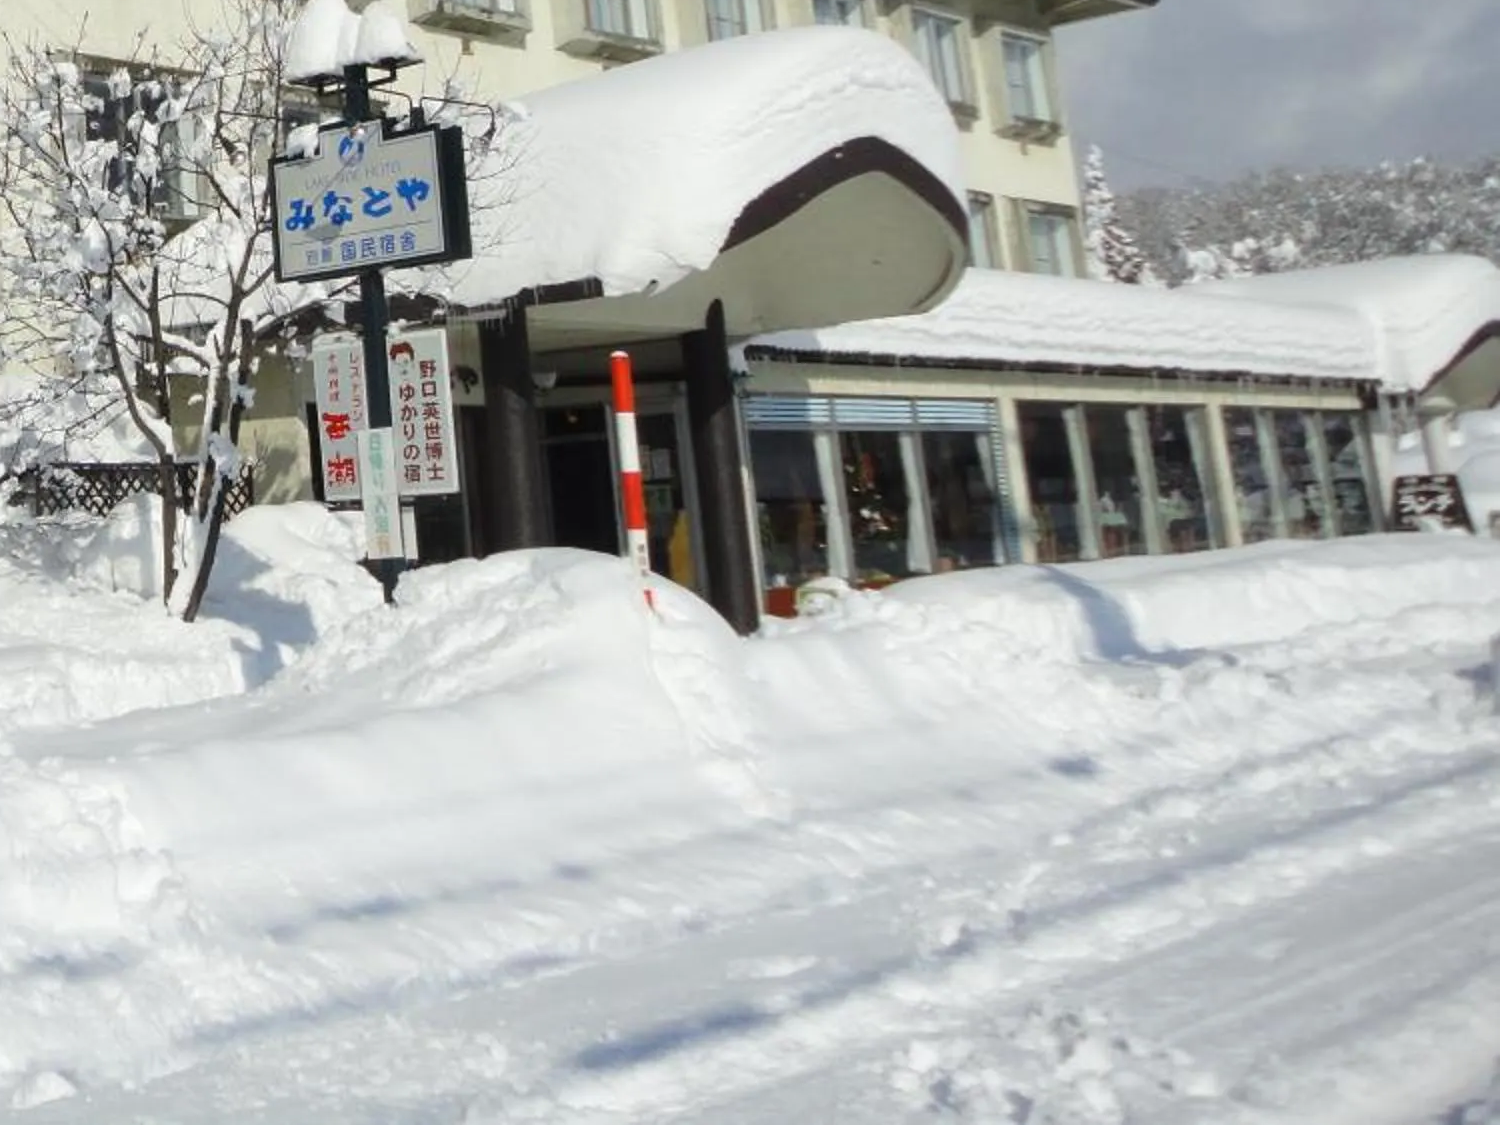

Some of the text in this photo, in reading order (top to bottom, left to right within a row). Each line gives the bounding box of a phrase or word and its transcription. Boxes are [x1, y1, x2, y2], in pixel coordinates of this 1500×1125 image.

[285, 178, 430, 231] みなとや
[340, 230, 416, 262] 国民宿舎
[399, 383, 421, 482] ゆかりの宿
[420, 360, 444, 480] 野口英世博士
